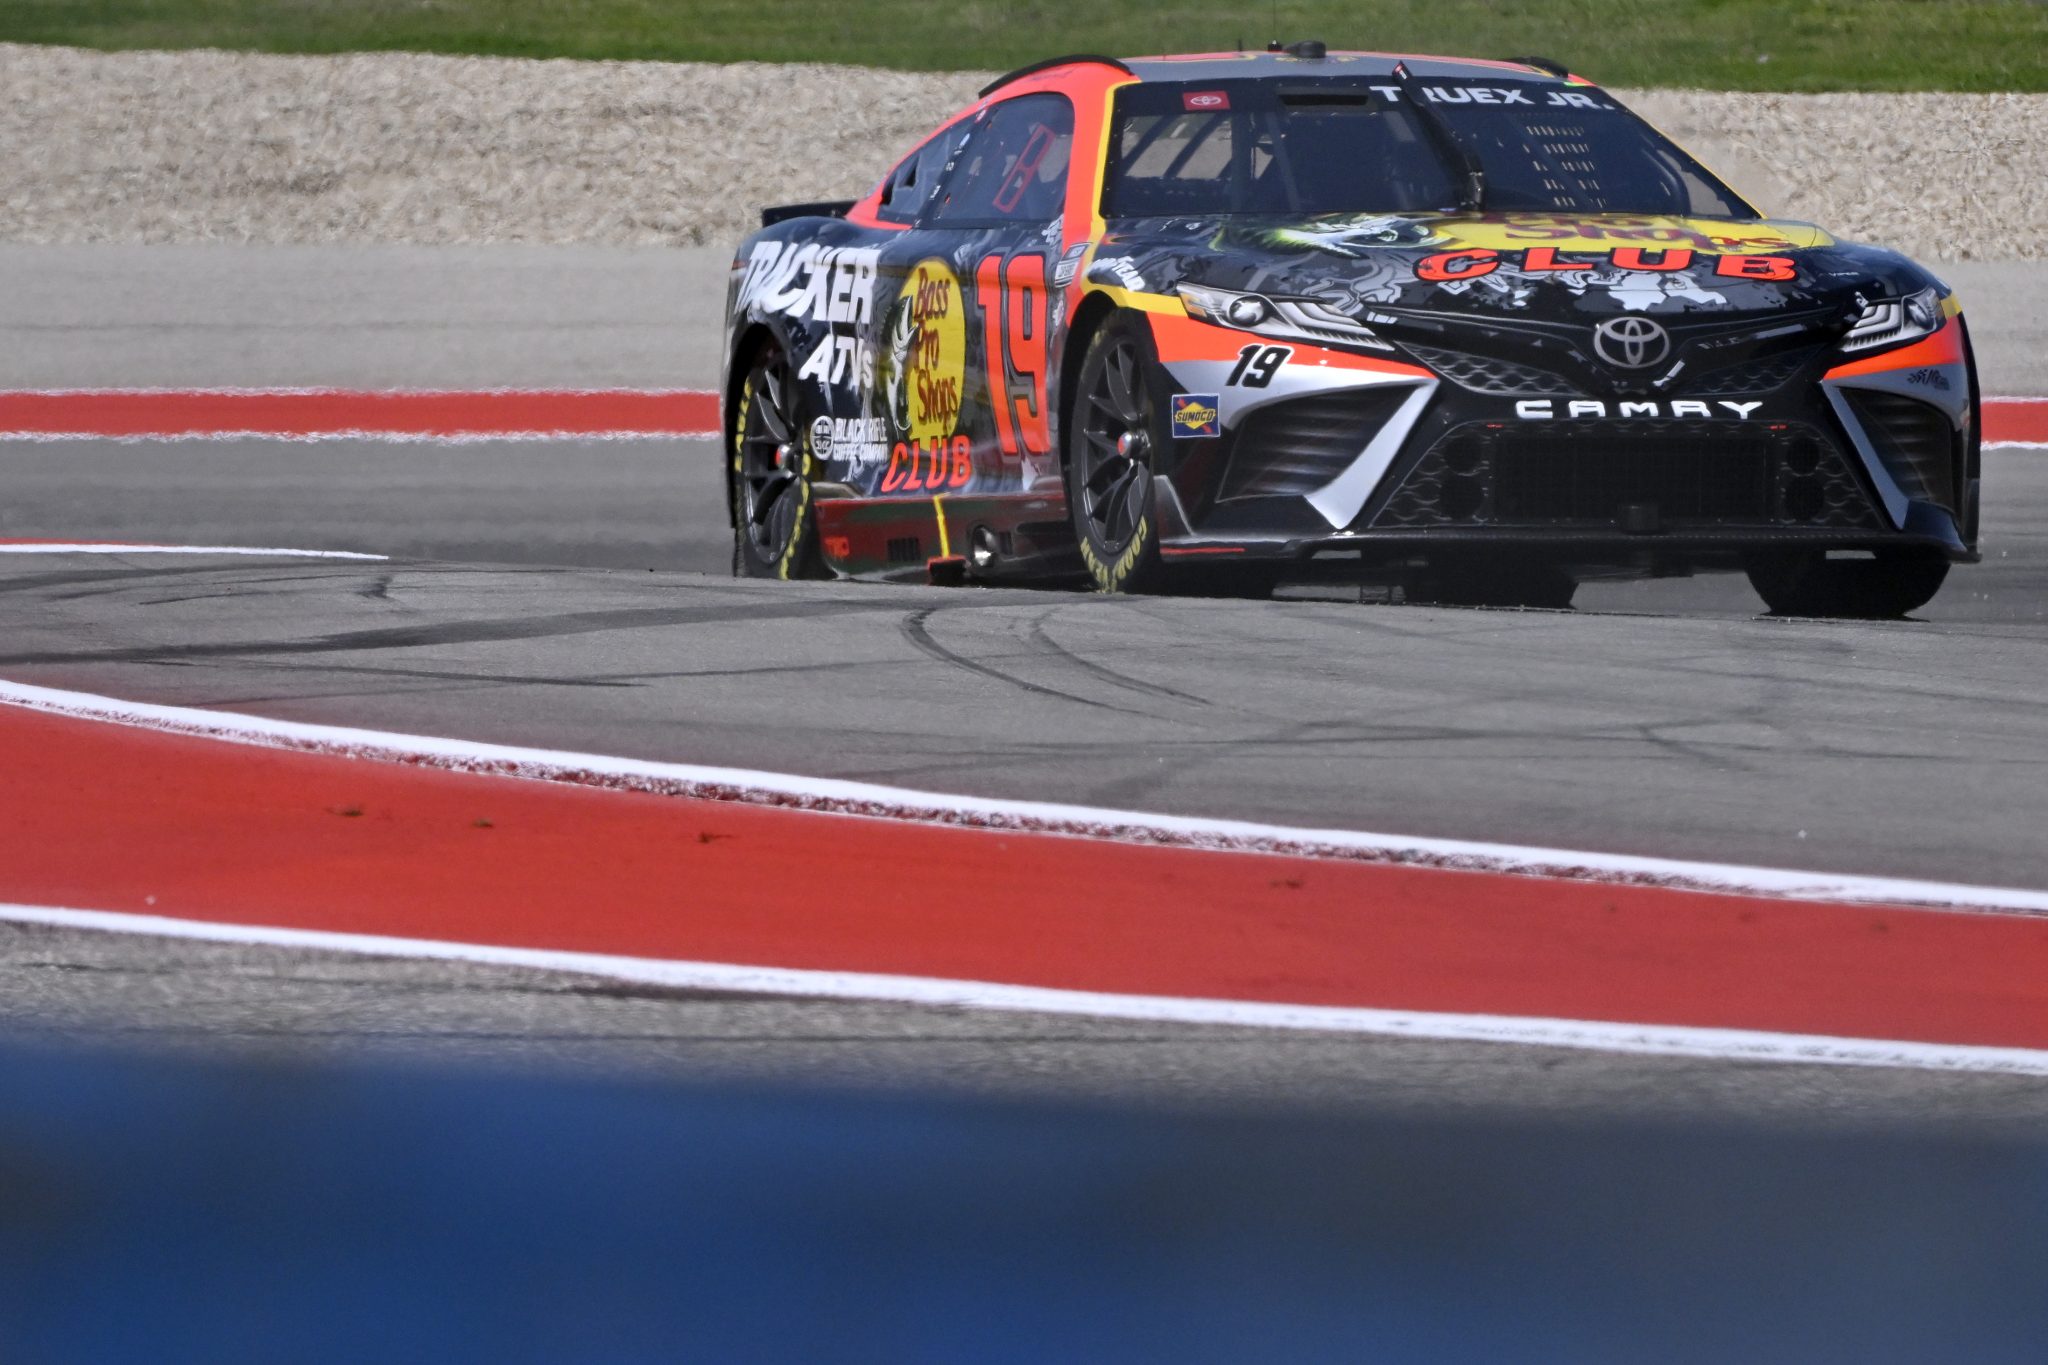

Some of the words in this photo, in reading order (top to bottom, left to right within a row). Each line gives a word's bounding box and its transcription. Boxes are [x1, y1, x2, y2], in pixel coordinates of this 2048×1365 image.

[1547, 92, 1615, 110] JR.
[734, 240, 881, 324] TRACKER
[1417, 247, 1796, 281] CLUB
[913, 267, 950, 322] Bass
[798, 334, 873, 389] ATVs
[913, 321, 940, 373] Pro
[976, 254, 1051, 455] 19
[1225, 344, 1293, 389] 19
[916, 369, 958, 433] Shops
[1176, 410, 1216, 422] SUNOCO
[1516, 400, 1763, 419] CAMRY
[834, 417, 865, 441] BLACK
[881, 434, 973, 492] CLUB
